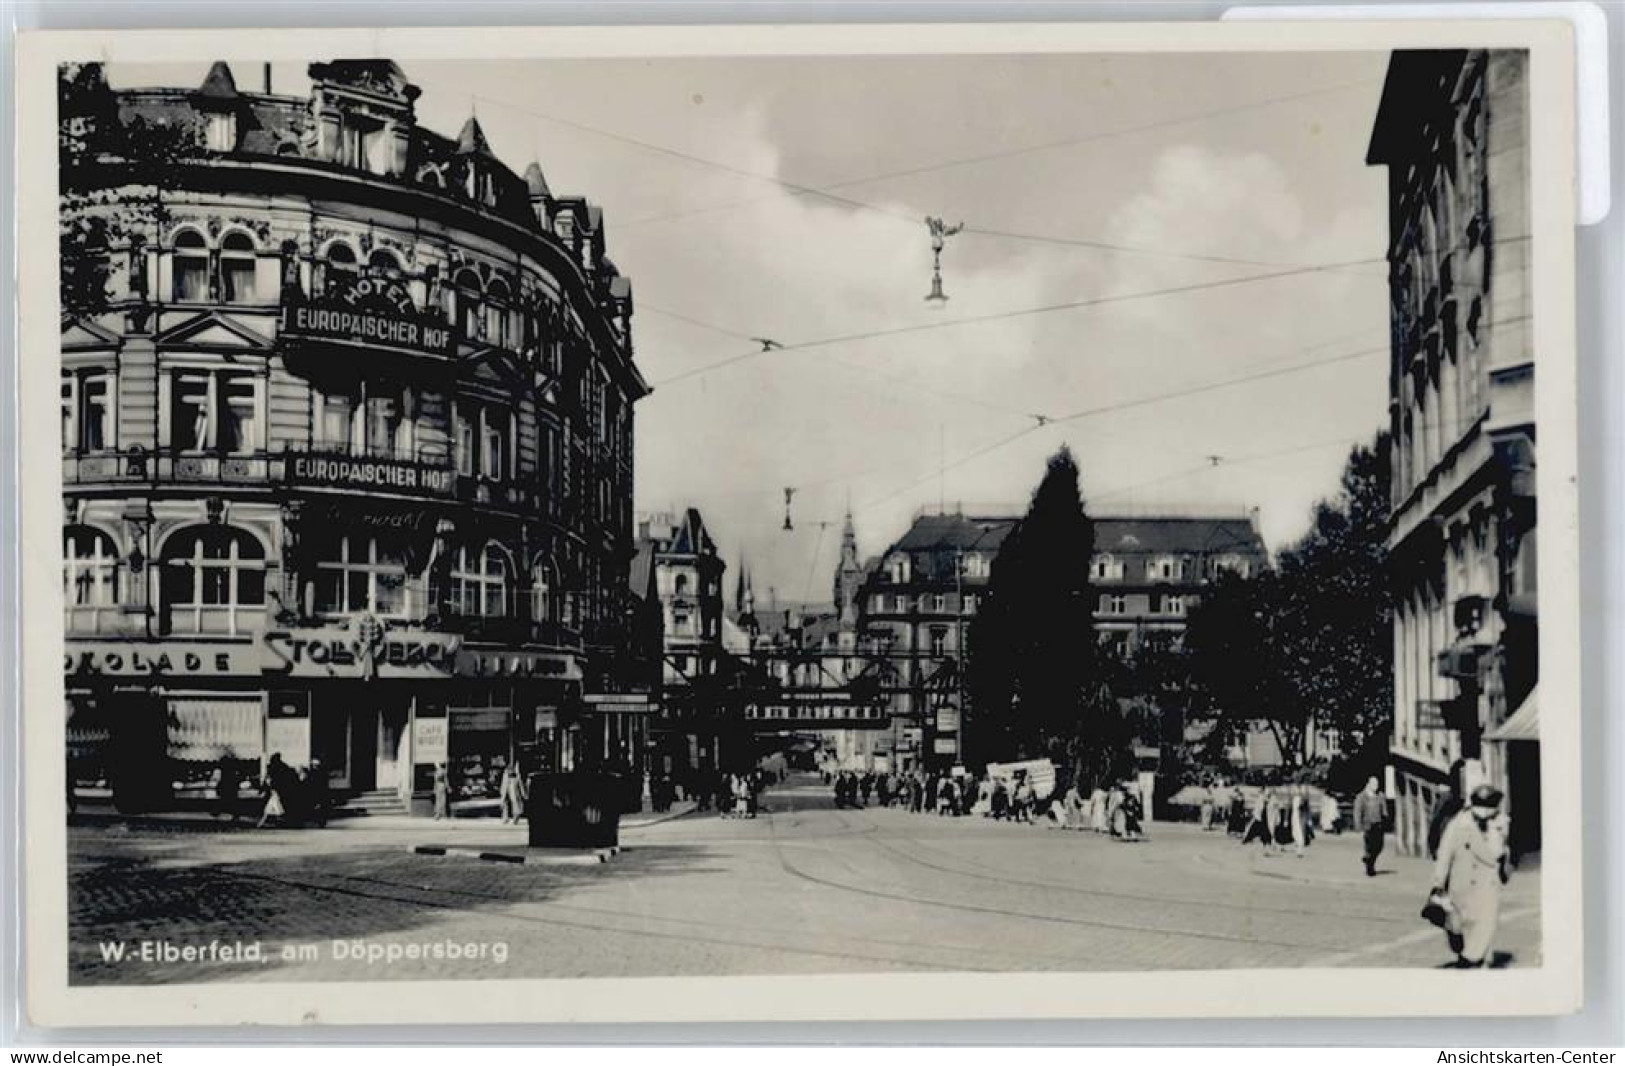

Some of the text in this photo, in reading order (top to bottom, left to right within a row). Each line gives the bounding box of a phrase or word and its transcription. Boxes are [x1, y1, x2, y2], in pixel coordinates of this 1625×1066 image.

[343, 279, 410, 314] HOTEL
[423, 327, 450, 348] HOF
[421, 470, 450, 489] HOF
